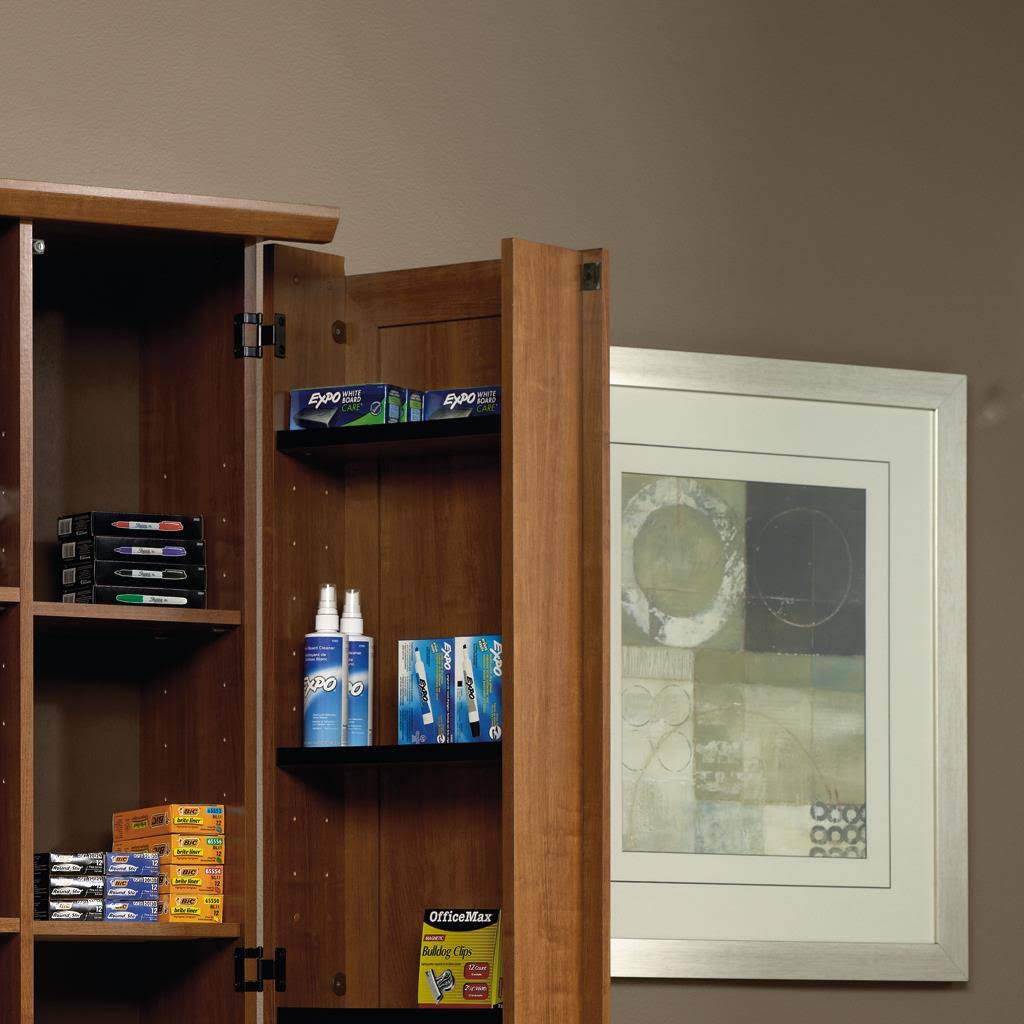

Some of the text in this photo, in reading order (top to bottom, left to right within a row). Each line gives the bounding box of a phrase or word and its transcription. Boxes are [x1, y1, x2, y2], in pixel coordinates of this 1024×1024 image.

[308, 392, 341, 409] EXPO
[342, 403, 360, 412] CARE
[443, 392, 476, 410] EXPO
[442, 642, 452, 670] EXPO
[490, 640, 502, 676] EXPO
[418, 678, 428, 702] EXPO
[466, 676, 475, 700] EXPO
[430, 910, 492, 922] OfficeMax
[422, 945, 472, 960] Bulldog Clips
